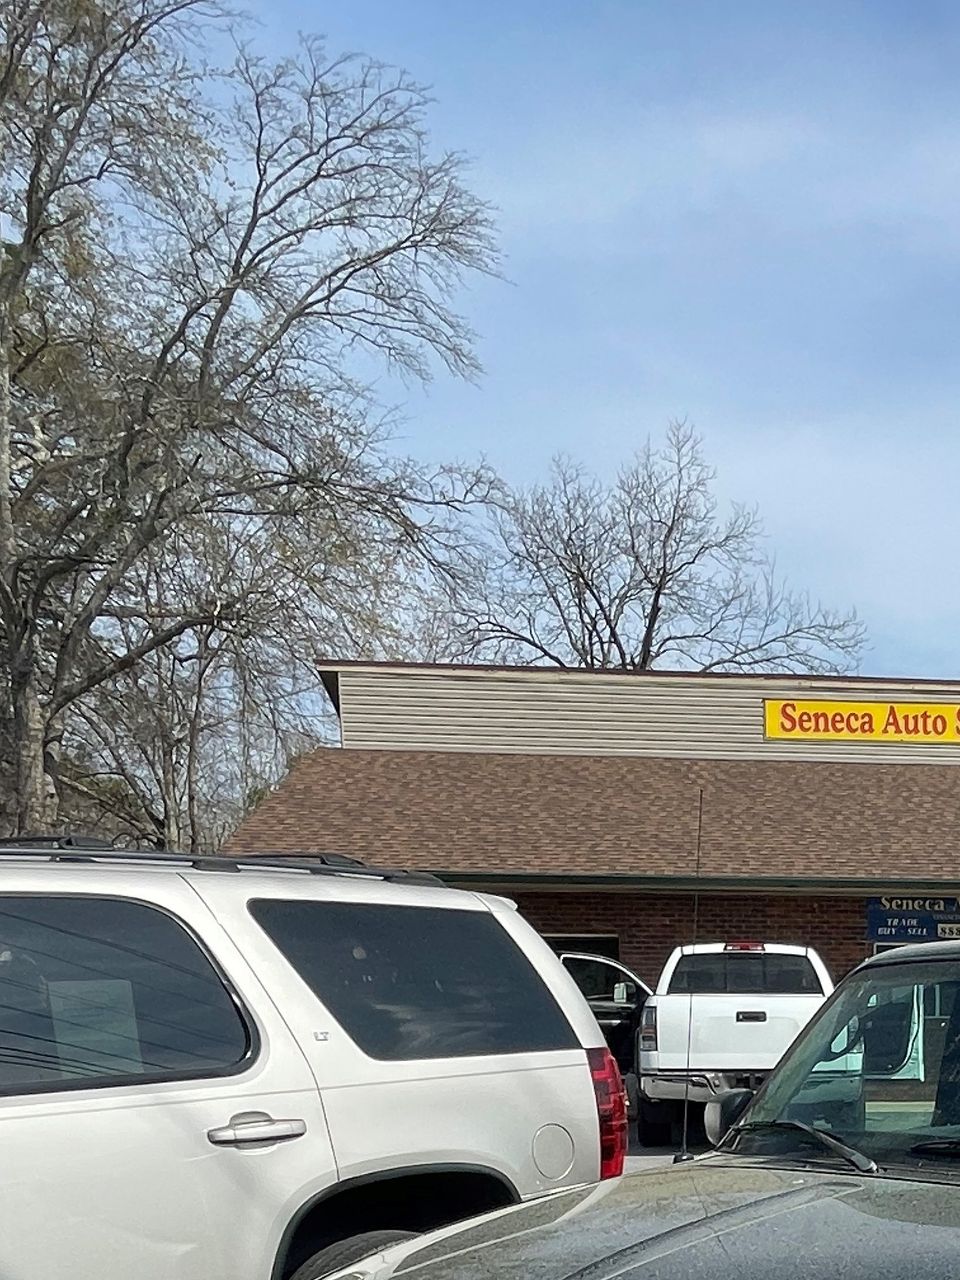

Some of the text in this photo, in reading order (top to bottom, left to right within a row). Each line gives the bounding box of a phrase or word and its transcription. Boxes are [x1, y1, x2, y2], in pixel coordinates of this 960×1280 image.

[780, 702, 875, 735] Seneca
[882, 704, 947, 736] Auto
[880, 896, 945, 911] Seneca
[886, 918, 919, 926] TRADE
[877, 927, 897, 935] BUY
[907, 927, 928, 936] SELL
